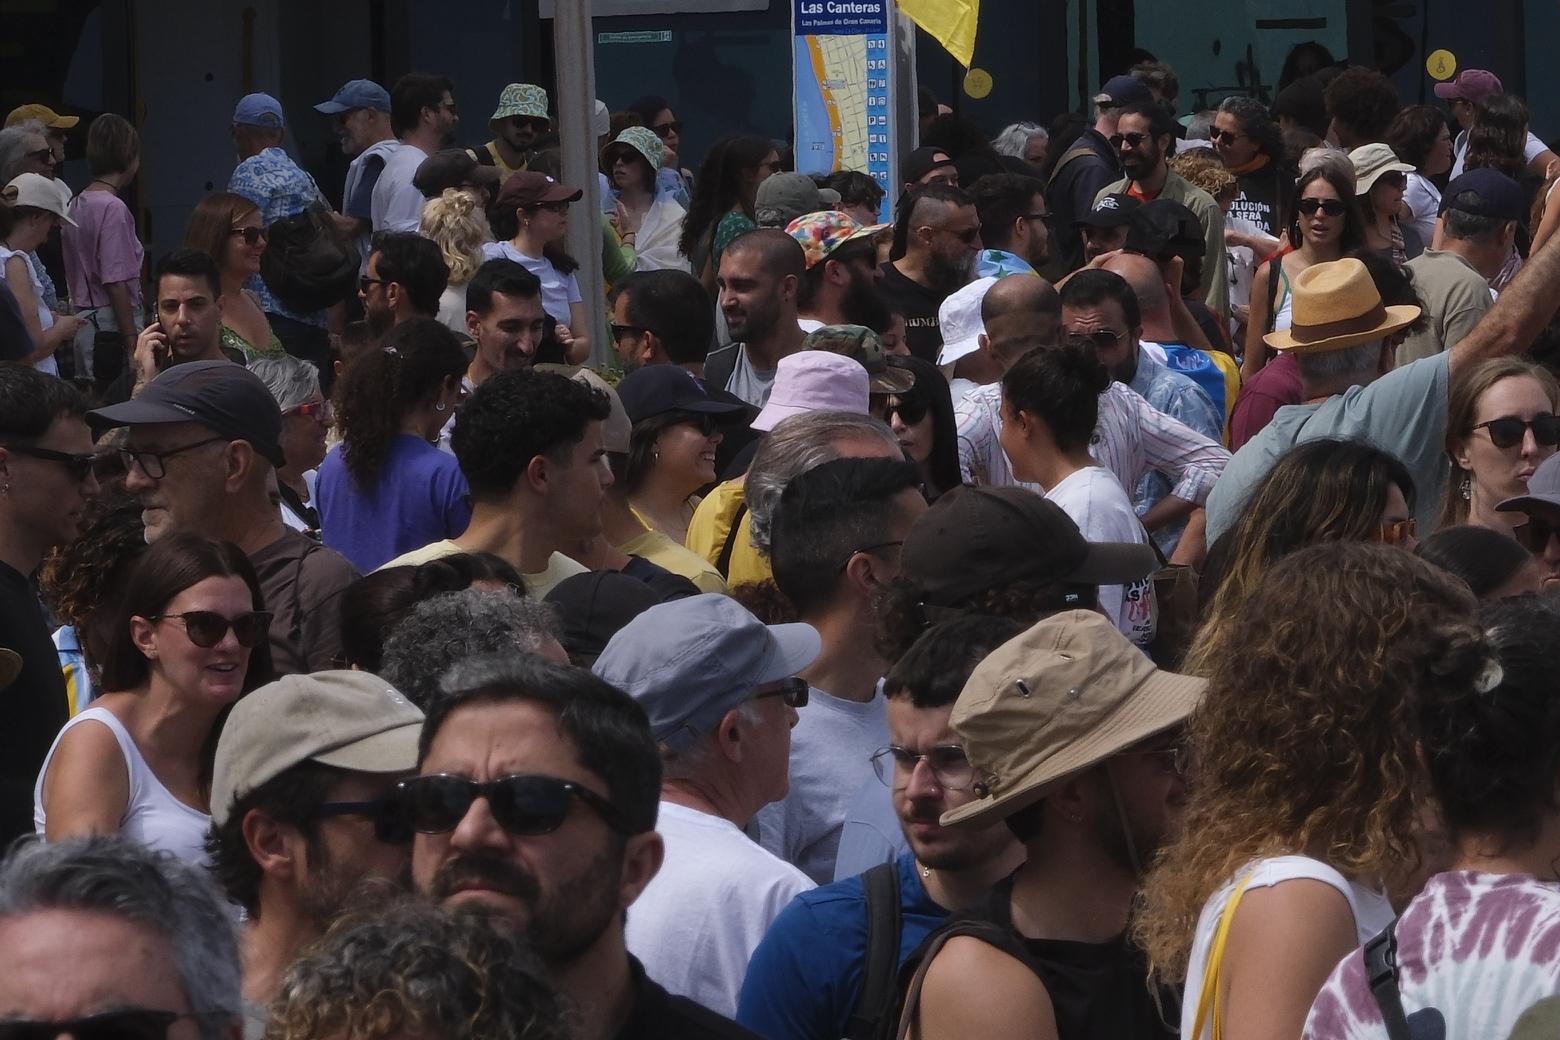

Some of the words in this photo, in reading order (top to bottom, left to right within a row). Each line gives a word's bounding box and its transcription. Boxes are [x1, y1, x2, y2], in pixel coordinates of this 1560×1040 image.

[801, 1, 823, 14] Las
[827, 1, 881, 13] Canteras
[801, 19, 812, 27] Las
[813, 19, 833, 27] Palmas
[859, 17, 881, 25] Canaria
